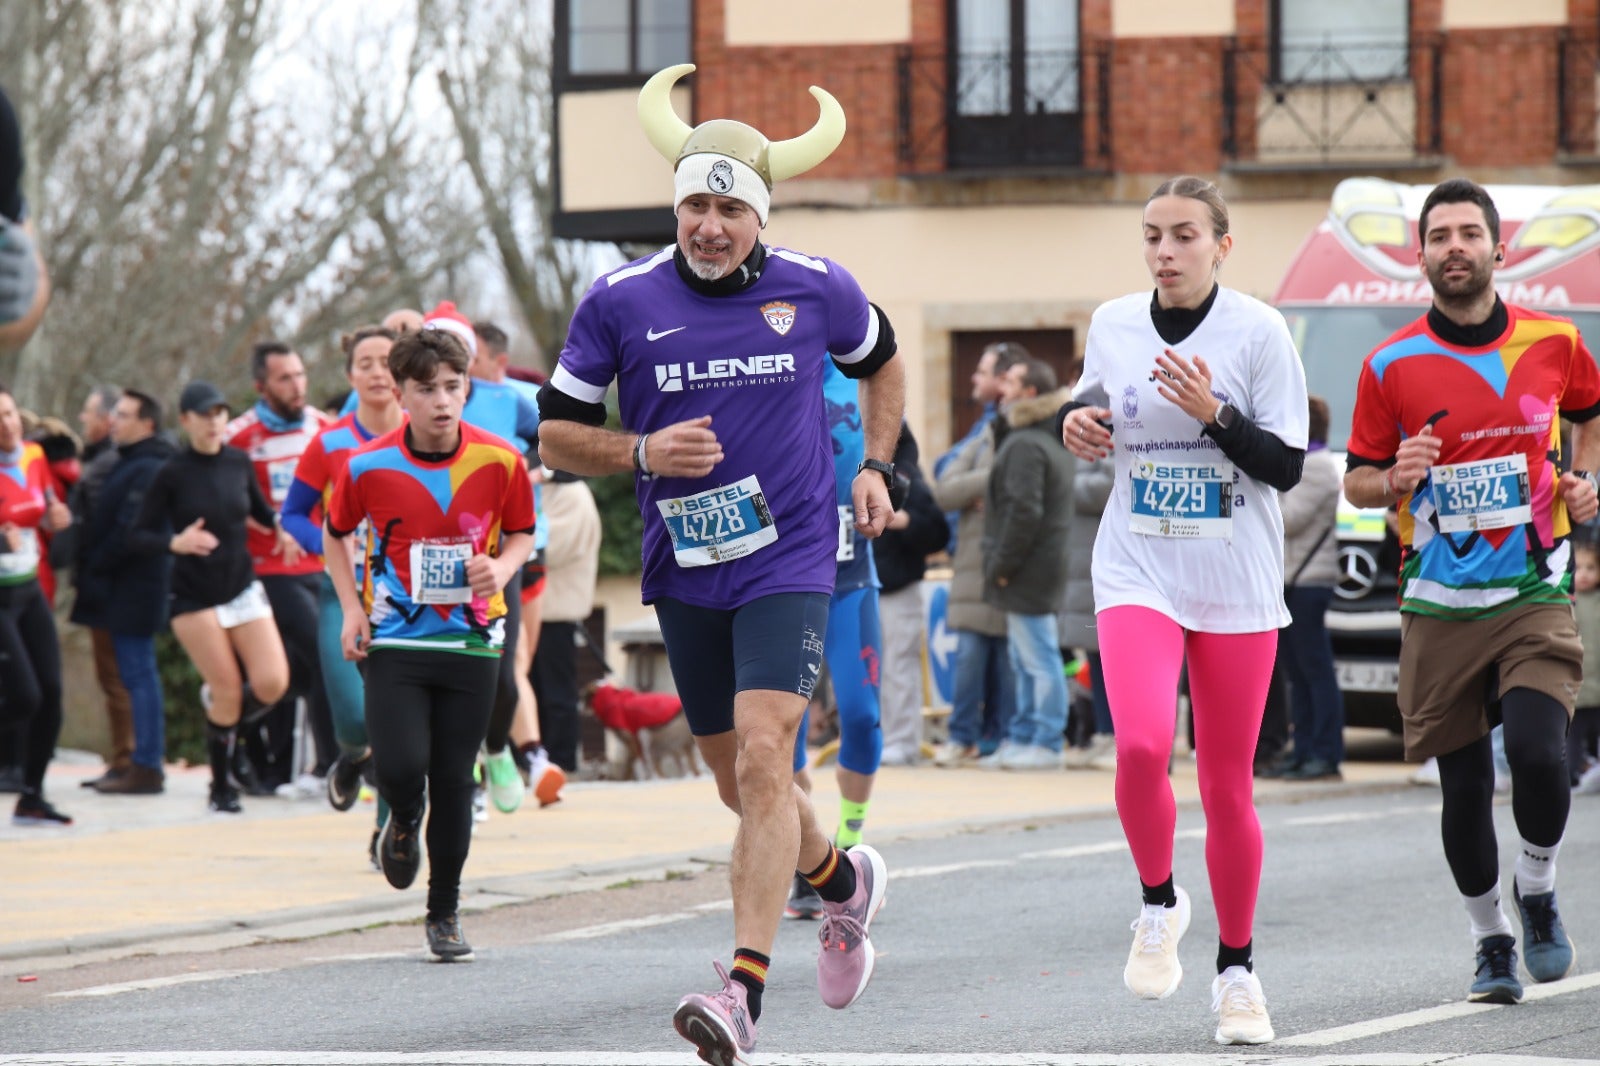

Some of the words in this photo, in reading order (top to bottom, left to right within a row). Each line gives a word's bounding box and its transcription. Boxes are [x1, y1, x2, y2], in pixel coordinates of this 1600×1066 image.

[688, 353, 797, 381] LENER
[689, 375, 796, 390] EMPRENDIMIENTOS
[1156, 466, 1222, 479] SETEL
[1456, 461, 1518, 479] SETEL
[684, 485, 750, 512] SETEL
[1143, 481, 1206, 513] 4229
[1446, 477, 1508, 510] 3524
[682, 503, 746, 541] 4228
